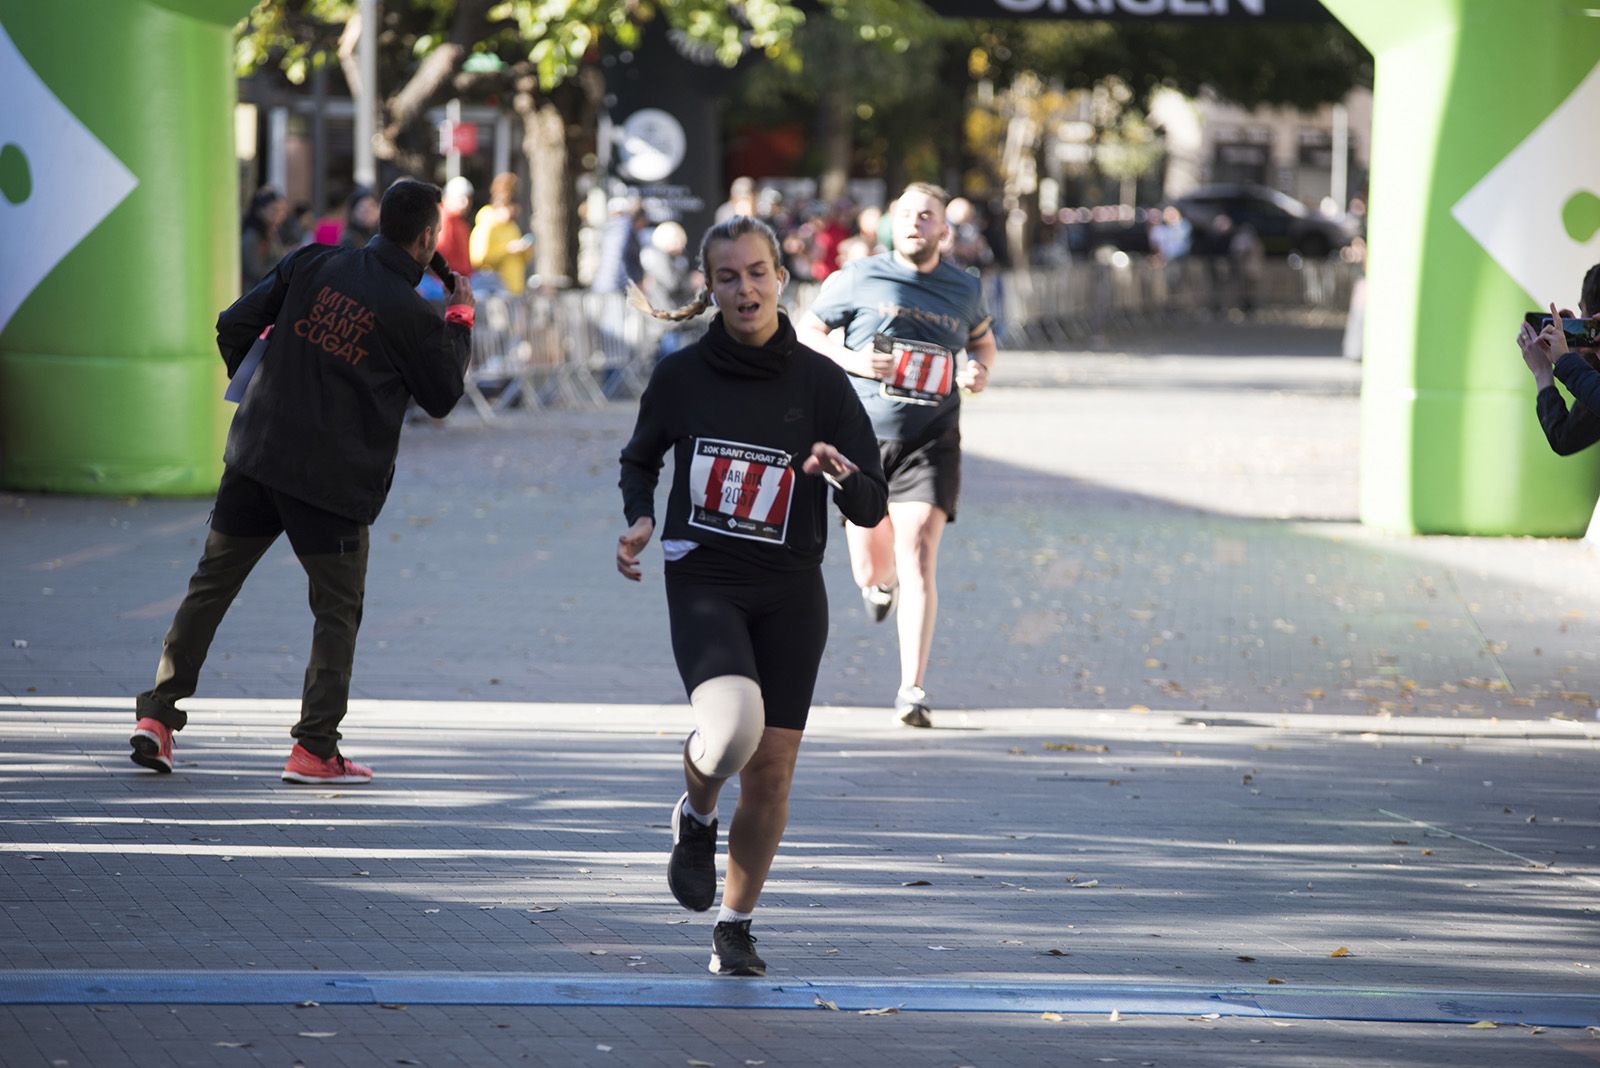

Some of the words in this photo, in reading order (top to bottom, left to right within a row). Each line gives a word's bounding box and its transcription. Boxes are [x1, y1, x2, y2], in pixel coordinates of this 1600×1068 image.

[310, 303, 369, 343] SANT
[317, 286, 374, 331] MITJA
[294, 319, 369, 365] CUGAT
[702, 445, 720, 454] 10K
[720, 447, 745, 458] SANT
[744, 451, 776, 464] CUGAT
[776, 457, 789, 466] 22
